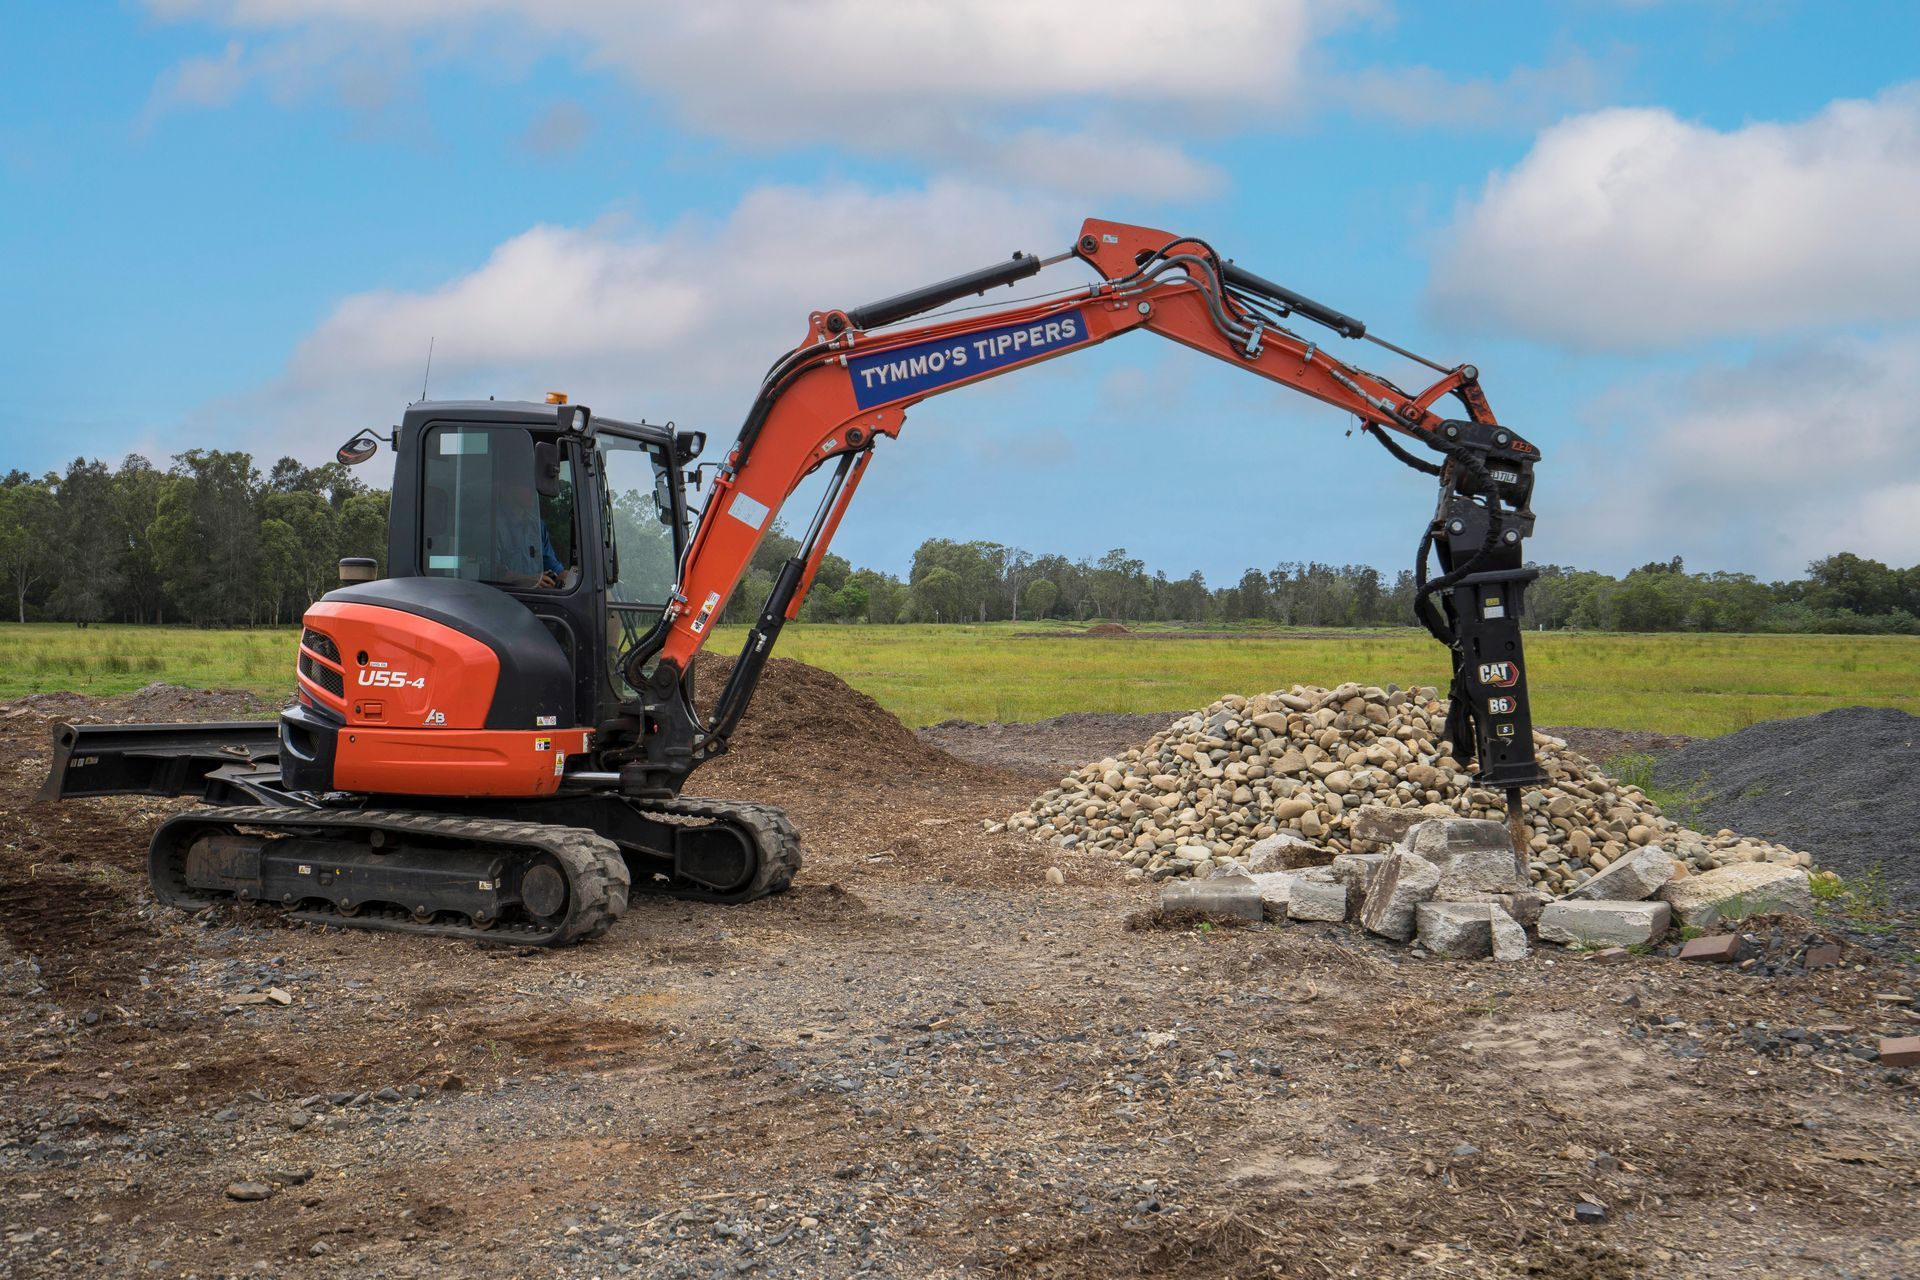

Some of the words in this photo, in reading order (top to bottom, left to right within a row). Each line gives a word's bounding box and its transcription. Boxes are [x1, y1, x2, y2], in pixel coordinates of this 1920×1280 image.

[860, 346, 968, 388] TYMMO'S
[973, 318, 1077, 360] TIPPERS
[358, 669, 425, 689] U55-4
[1479, 663, 1508, 683] CAT
[1489, 698, 1508, 713] B6
